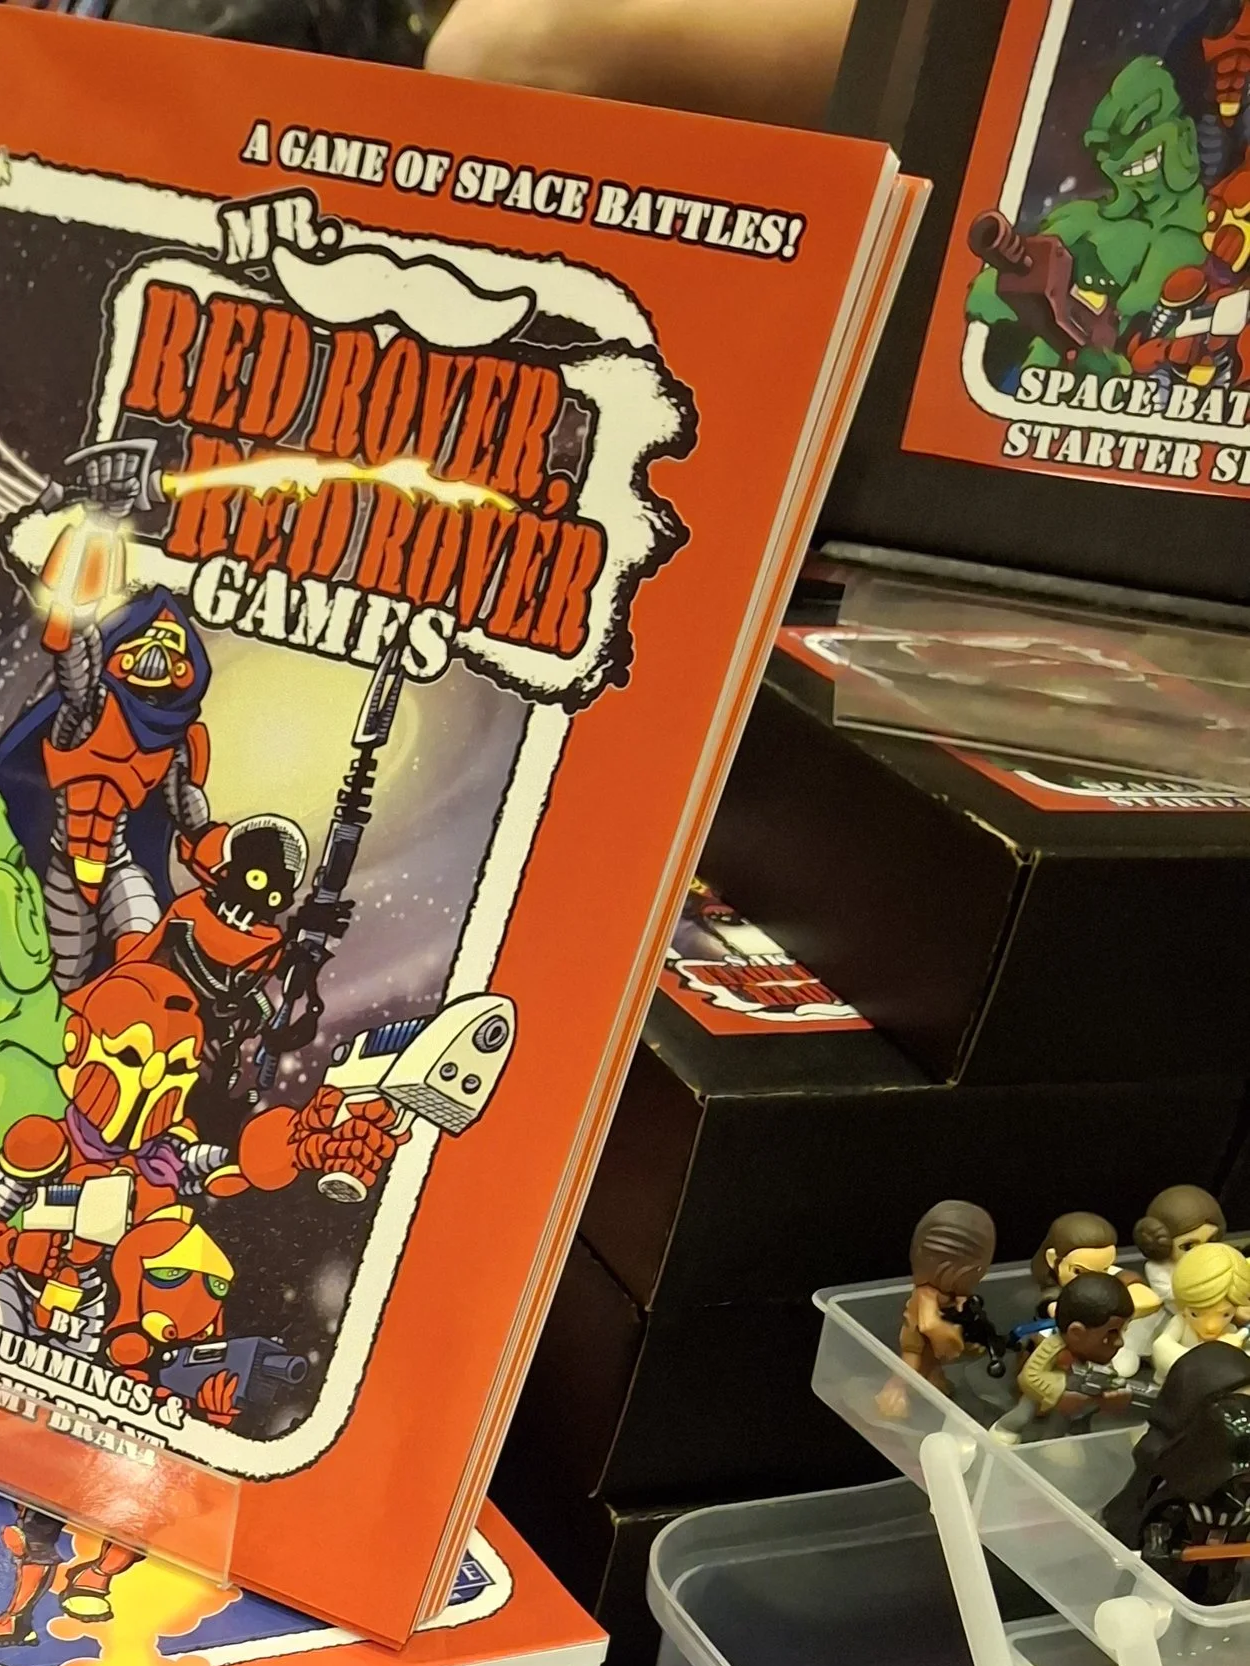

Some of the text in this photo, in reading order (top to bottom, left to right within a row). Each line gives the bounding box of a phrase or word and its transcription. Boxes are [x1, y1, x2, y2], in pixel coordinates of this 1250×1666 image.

[241, 122, 804, 258] A GAME OF SPACE BATTLES!
[222, 195, 338, 262] MR.
[123, 285, 311, 437] RED
[1016, 366, 1159, 415] SPACE
[1002, 422, 1200, 479] STARTER
[166, 434, 603, 653] RED ROVER
[192, 555, 456, 678] GAMES
[49, 1310, 86, 1341] BY
[47, 1397, 167, 1468] BRANT
[154, 1393, 187, 1429] &
